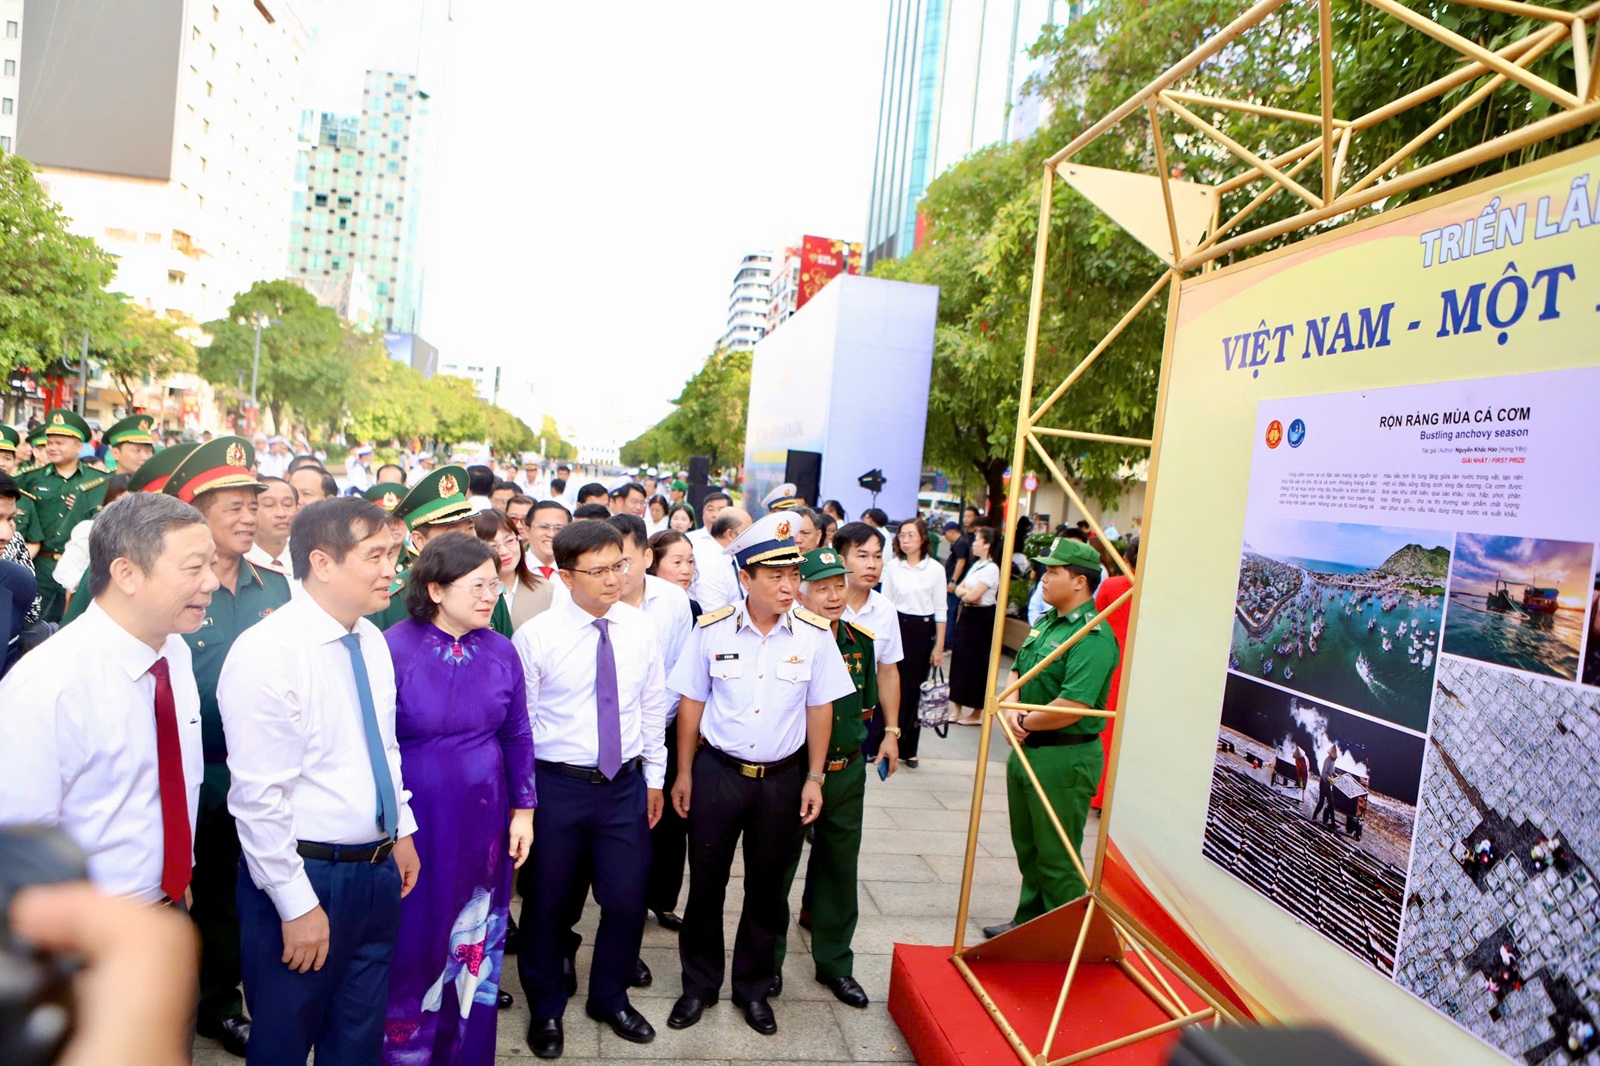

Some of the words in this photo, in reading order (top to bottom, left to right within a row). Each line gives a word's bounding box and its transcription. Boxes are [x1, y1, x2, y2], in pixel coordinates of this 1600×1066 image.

[1420, 196, 1527, 268] TRIỂN
[1222, 319, 1294, 379] VIỆT
[1302, 302, 1395, 359] NAM
[1407, 320, 1421, 331] -
[1436, 261, 1575, 345] MỘT
[1406, 411, 1438, 426] RÀNG
[1442, 408, 1470, 424] MÙA
[1474, 406, 1492, 423] CÁ
[1497, 406, 1530, 422] CƠM
[1420, 431, 1453, 441] Bustling
[1455, 429, 1492, 440] anchovy
[1494, 428, 1528, 438] season
